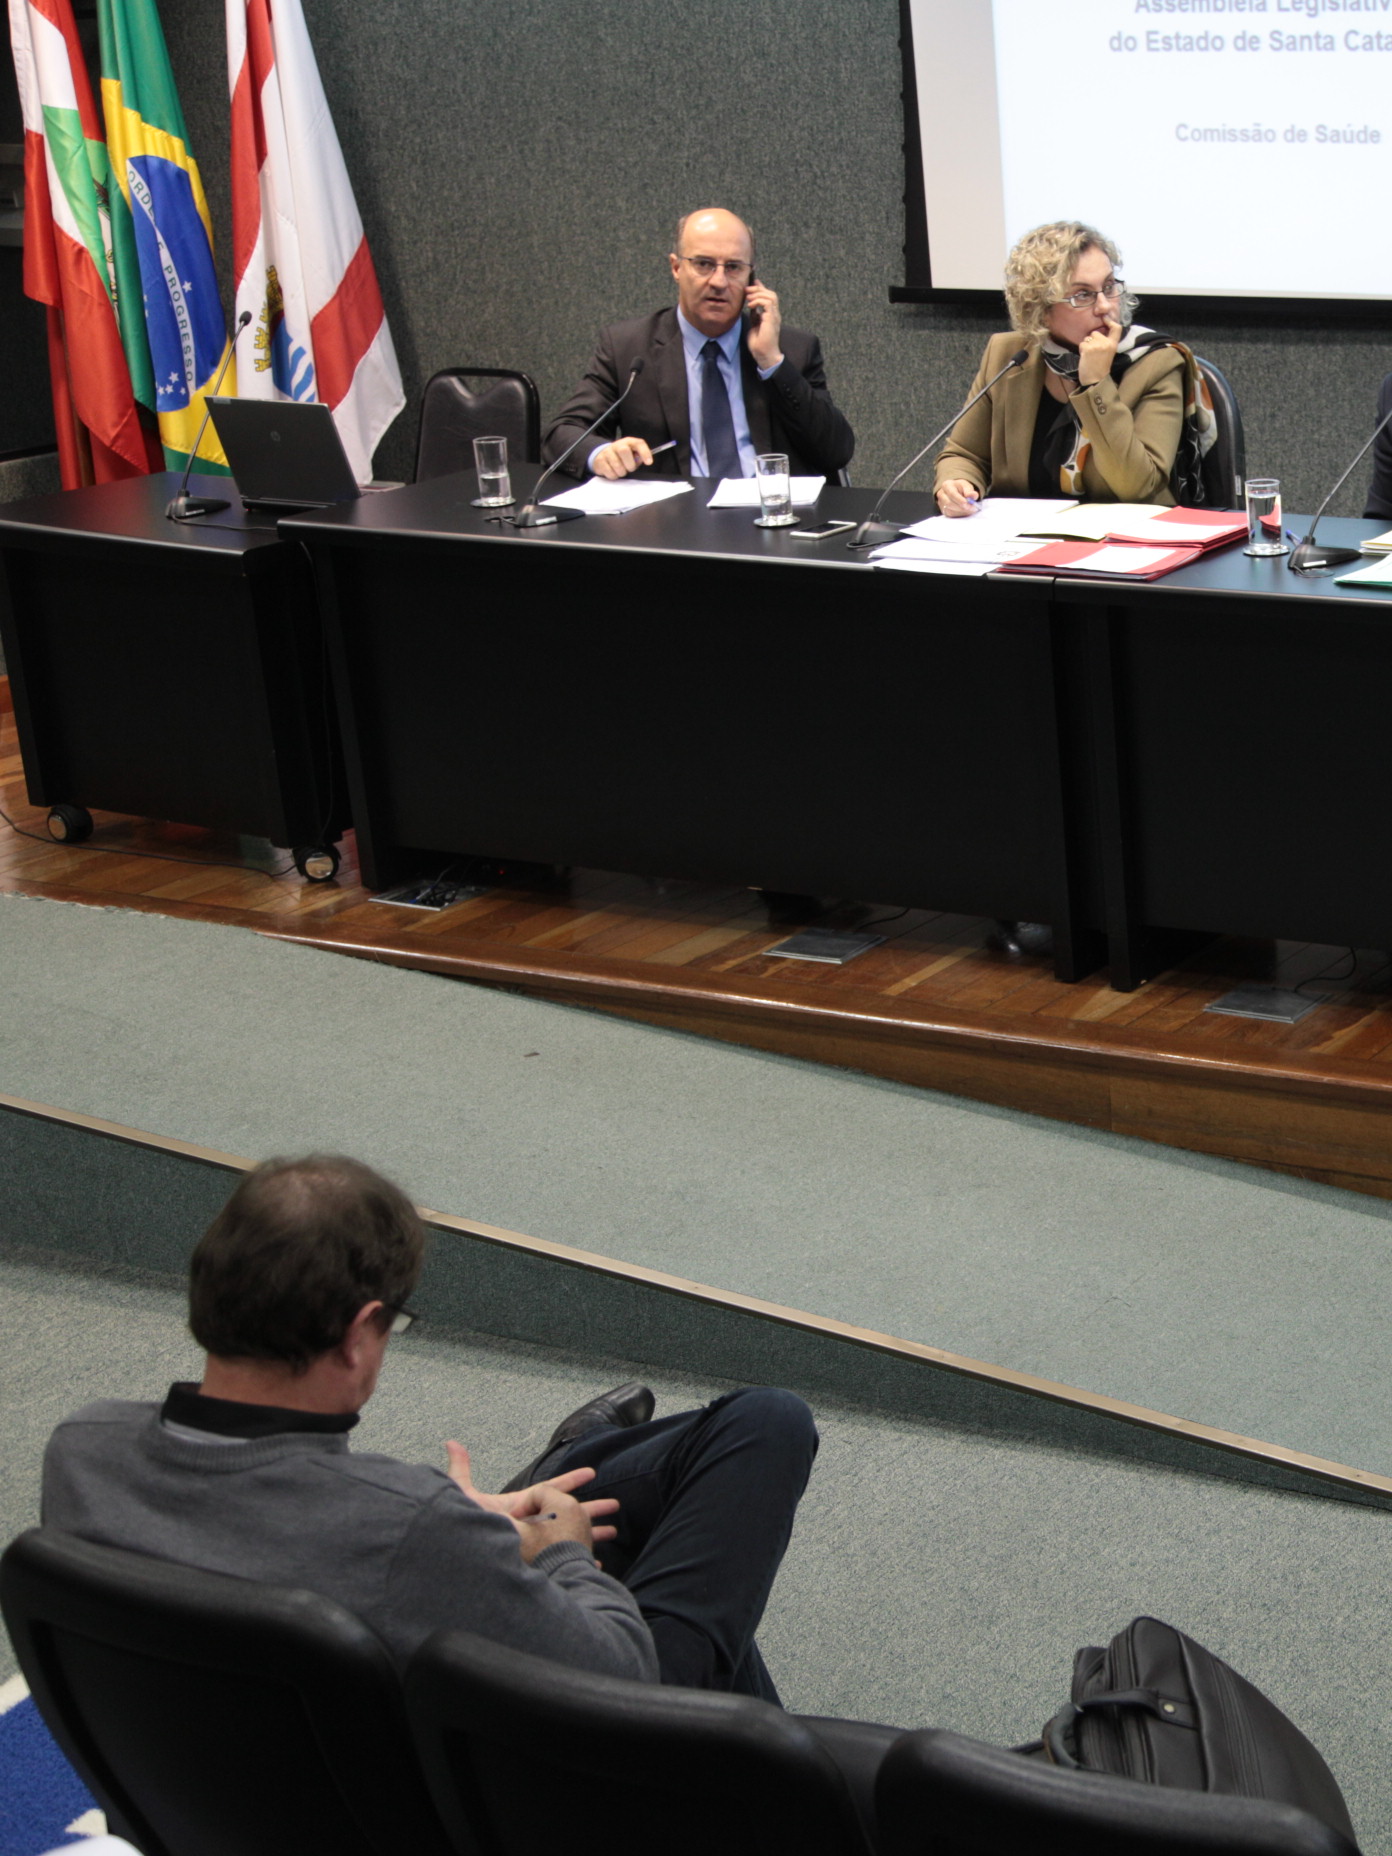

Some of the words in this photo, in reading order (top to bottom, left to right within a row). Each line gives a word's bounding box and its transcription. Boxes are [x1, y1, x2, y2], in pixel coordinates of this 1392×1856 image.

[1109, 30, 1138, 52] do
[1146, 30, 1226, 52] Estado
[1233, 30, 1261, 52] de
[1269, 29, 1336, 52] Santa
[1175, 122, 1277, 143] Comissão
[1284, 125, 1308, 143] de
[1314, 124, 1382, 144] Saúde
[164, 264, 193, 382] PROGRESSO
